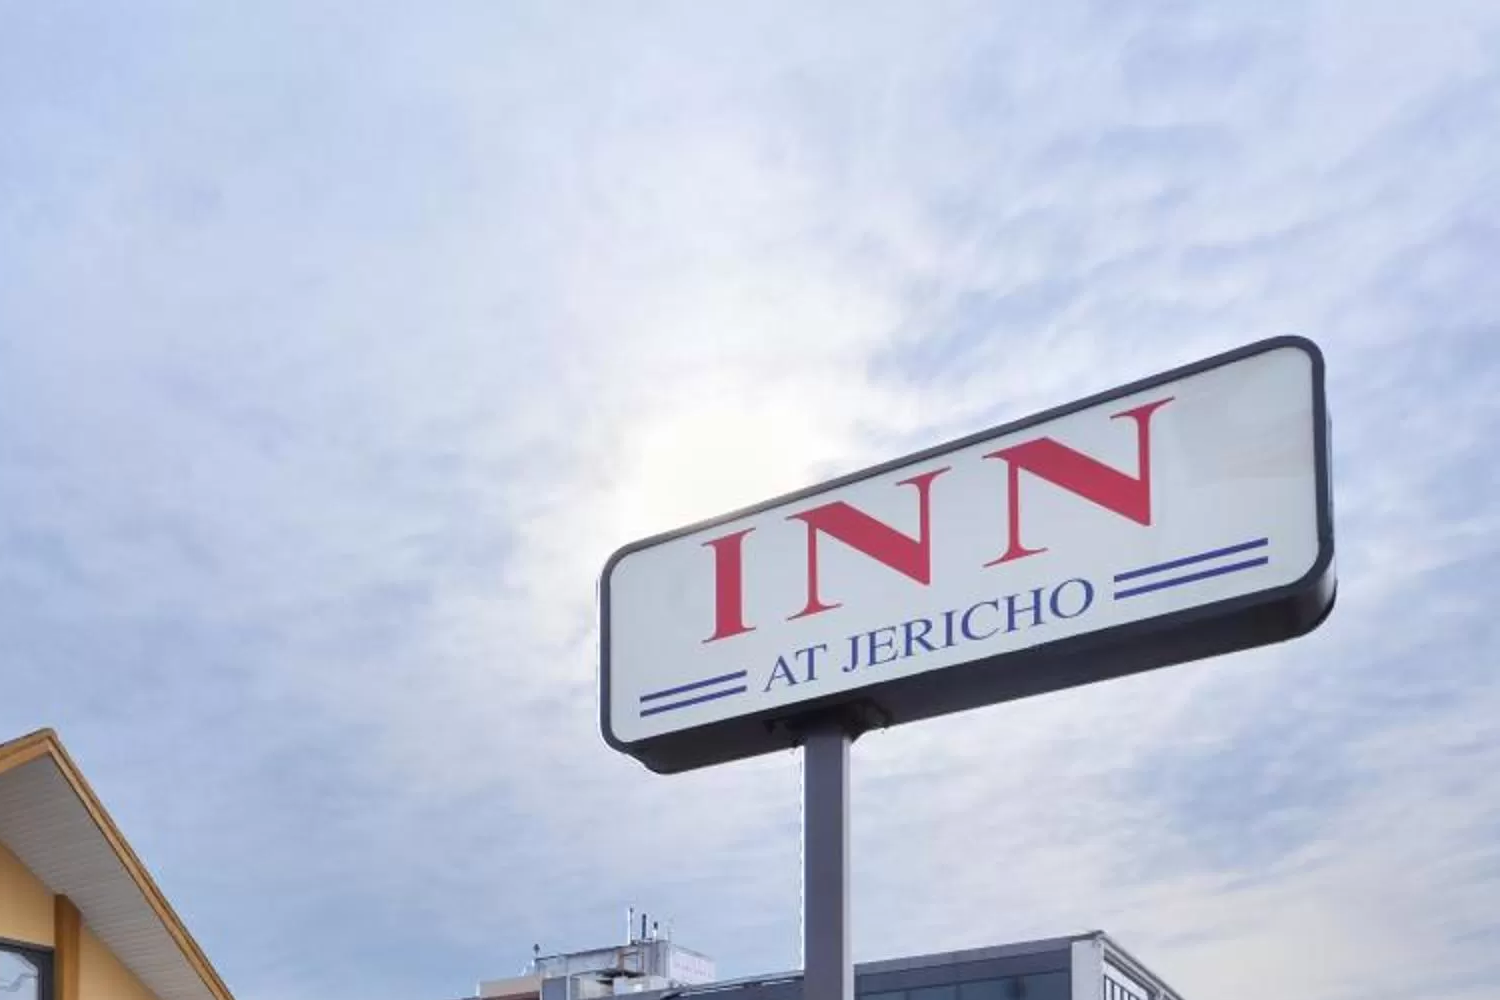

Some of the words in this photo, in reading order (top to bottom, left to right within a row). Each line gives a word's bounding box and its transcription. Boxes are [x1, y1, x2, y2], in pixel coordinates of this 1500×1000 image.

[702, 397, 1176, 644] INN
[763, 642, 828, 693] AT
[842, 577, 1096, 674] JERICHO
